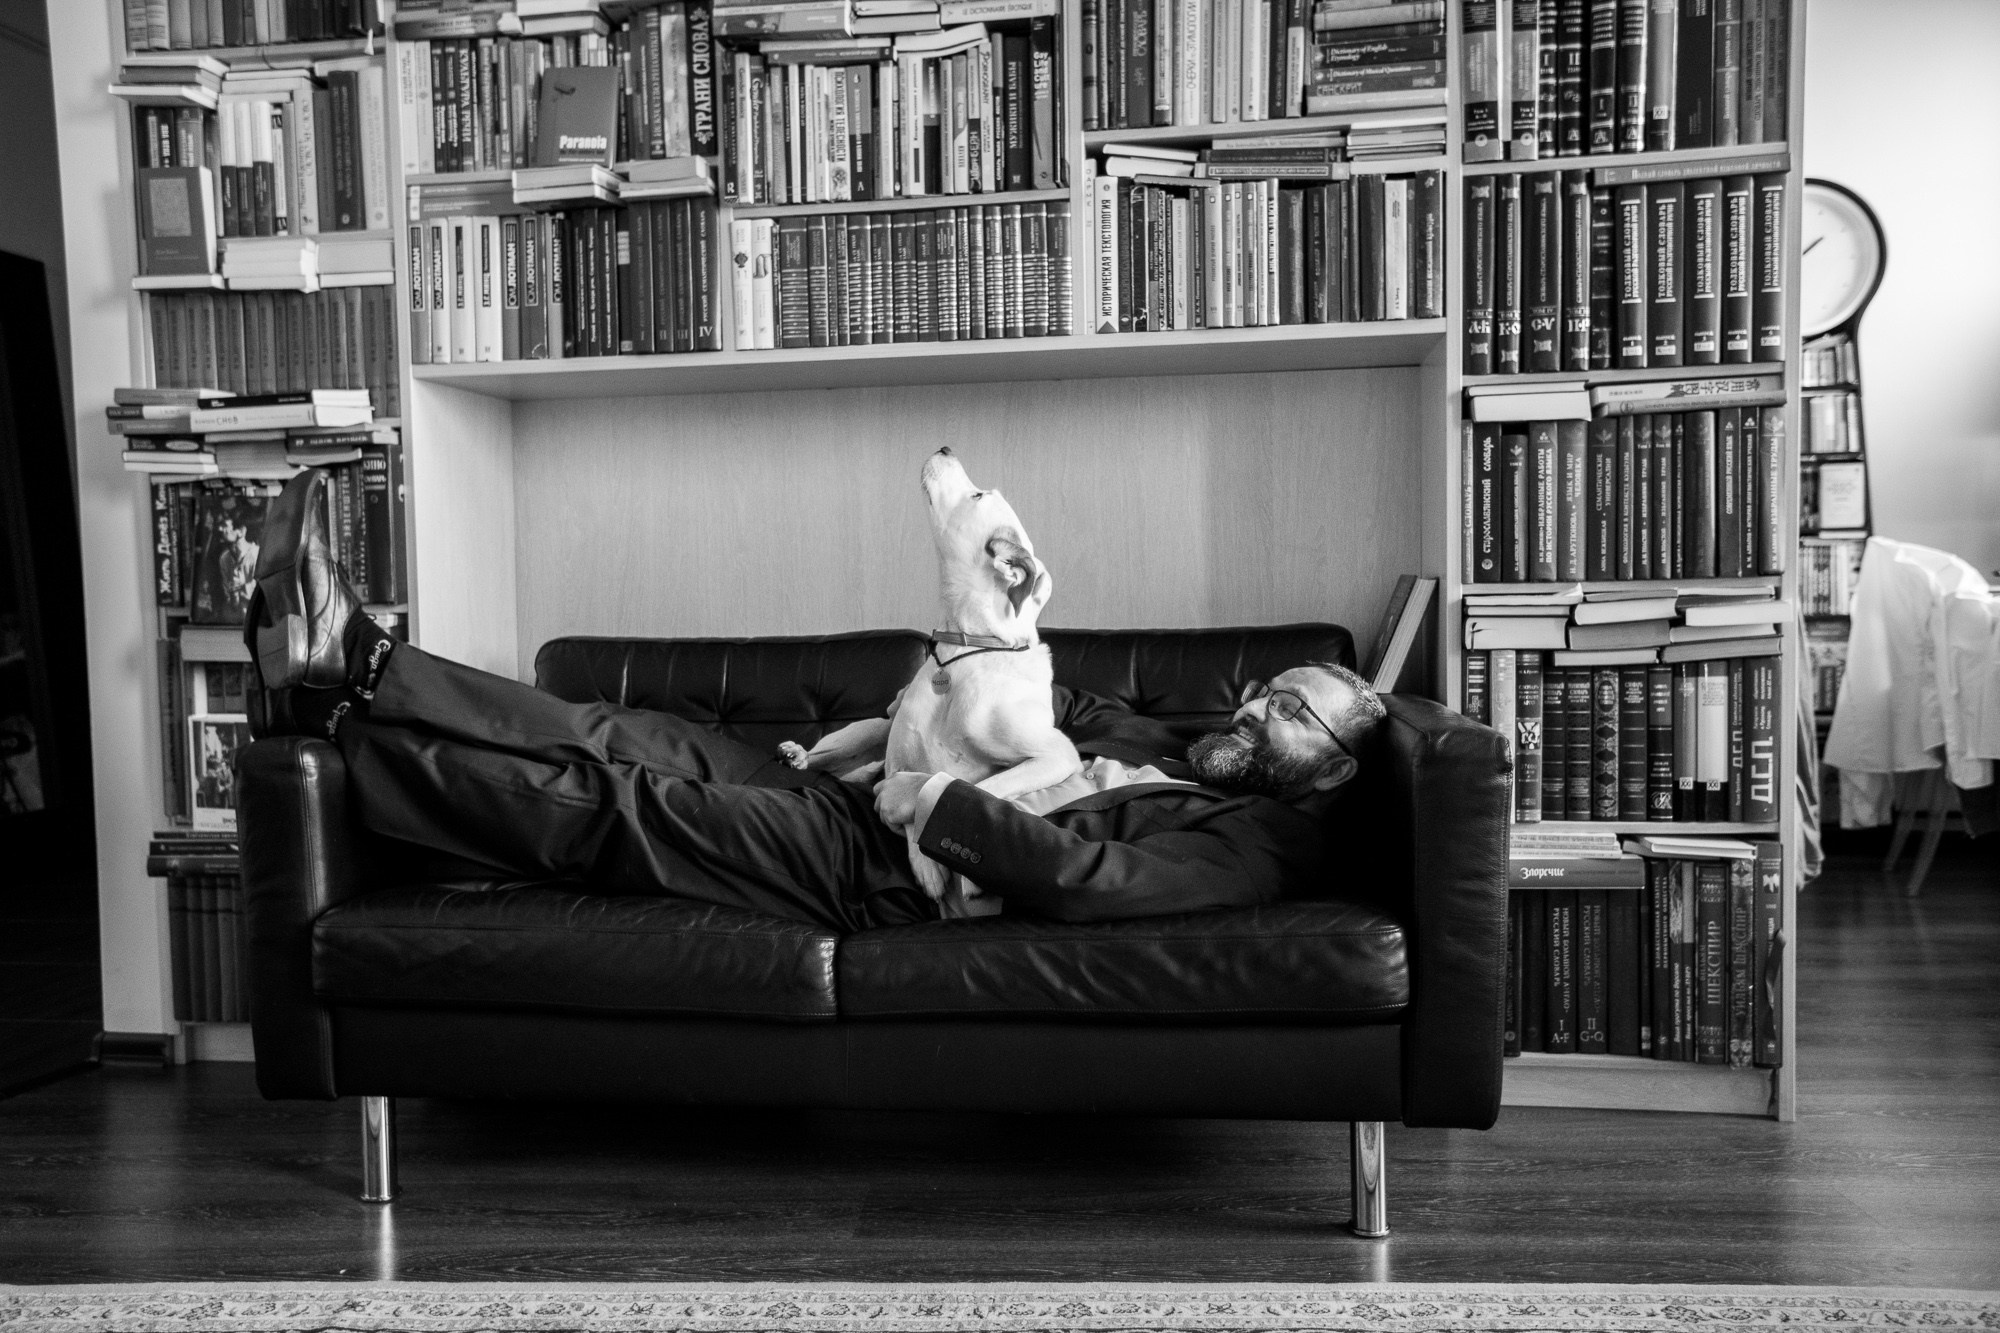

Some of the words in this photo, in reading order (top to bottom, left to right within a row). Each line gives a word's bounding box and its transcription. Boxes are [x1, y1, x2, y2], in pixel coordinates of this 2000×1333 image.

[691, 21, 710, 74] СЛОВА
[1137, 11, 1148, 56] СЛОВАРЬ
[460, 48, 471, 108] КУЛЬТУРА
[979, 50, 990, 104] PORNOGRAPHY
[1008, 61, 1017, 90] БАБЫ
[1569, 53, 1580, 66] II
[694, 77, 712, 131] ГРАНИ
[752, 77, 764, 111] Gender
[834, 71, 845, 116] ПСИХОЛОГИЯ
[461, 110, 472, 142] РЕЧИ
[559, 135, 607, 149] Paranoia
[835, 118, 846, 162] ТЕЛЕСНОСТИ
[969, 131, 979, 157] БЕРН
[1009, 102, 1018, 148] МУЖИКИ
[1101, 199, 1112, 253] ТЕКСТОЛОГИЯ
[1623, 205, 1631, 246] СЛОВАРЬ
[1658, 204, 1666, 246] СЛОВАРЬ
[1730, 197, 1738, 239] СЛОВАРЬ
[1764, 192, 1772, 233] СЛОВАРЬ
[1631, 223, 1639, 267] РАЗГОВОРНОЙ
[1704, 217, 1712, 262] РАЗГОВОРНОЙ
[1738, 215, 1746, 260] РАЗГОВОРНОЙ
[413, 248, 422, 290] ЛОТМАН
[434, 250, 442, 291] ЛОТМАН
[507, 243, 516, 287] ЛОТМАН
[527, 240, 535, 284] ЛОТМАН
[553, 239, 562, 282] ЛОТМАН
[1623, 248, 1631, 298] ТОЛКОВЫЙ
[1657, 247, 1666, 297] ТОЛКОВЫЙ
[1696, 242, 1704, 293] ТОЛКОВЫЙ
[1704, 263, 1712, 293] РУССКОЙ
[1729, 241, 1738, 292] ТОЛКОВЫЙ
[1738, 261, 1746, 291] РУССКОЙ
[1763, 236, 1772, 286] ТОЛКОВЫЙ
[1101, 256, 1113, 317] ИСТОРИЧЕСКАЯ
[1631, 268, 1639, 298] РУССКОЙ
[699, 326, 713, 337] IV
[1725, 451, 1733, 475] РУССКИЙ
[1464, 486, 1472, 527] СЛОВАРЬ
[1569, 512, 1577, 558] АРУТЮНОВА
[159, 559, 172, 593] Жиль
[1546, 552, 1552, 563] ПО
[1569, 566, 1577, 574] Н.
[1751, 736, 1773, 804] Д.С.П.
[1519, 867, 1566, 880] Злоречие
[1552, 907, 1560, 947] РУССКИЙ
[1562, 907, 1570, 937] НОВЫЙ
[1583, 904, 1591, 945] РУССКИЙ
[1593, 904, 1601, 935] НОВЫЙ
[1732, 906, 1746, 965] ШЕКСПИР
[1552, 949, 1560, 987] СЛОВАРЬ
[1562, 939, 1570, 978] БОЛЬШОЙ
[1583, 947, 1591, 986] СЛОВАРЬ
[1593, 937, 1601, 978] БОЛЬШОЙ
[1707, 920, 1721, 1005] ШЕКСПИР
[1734, 969, 1746, 1016] УИЛЬЯМ
[1588, 1018, 1596, 1030] II
